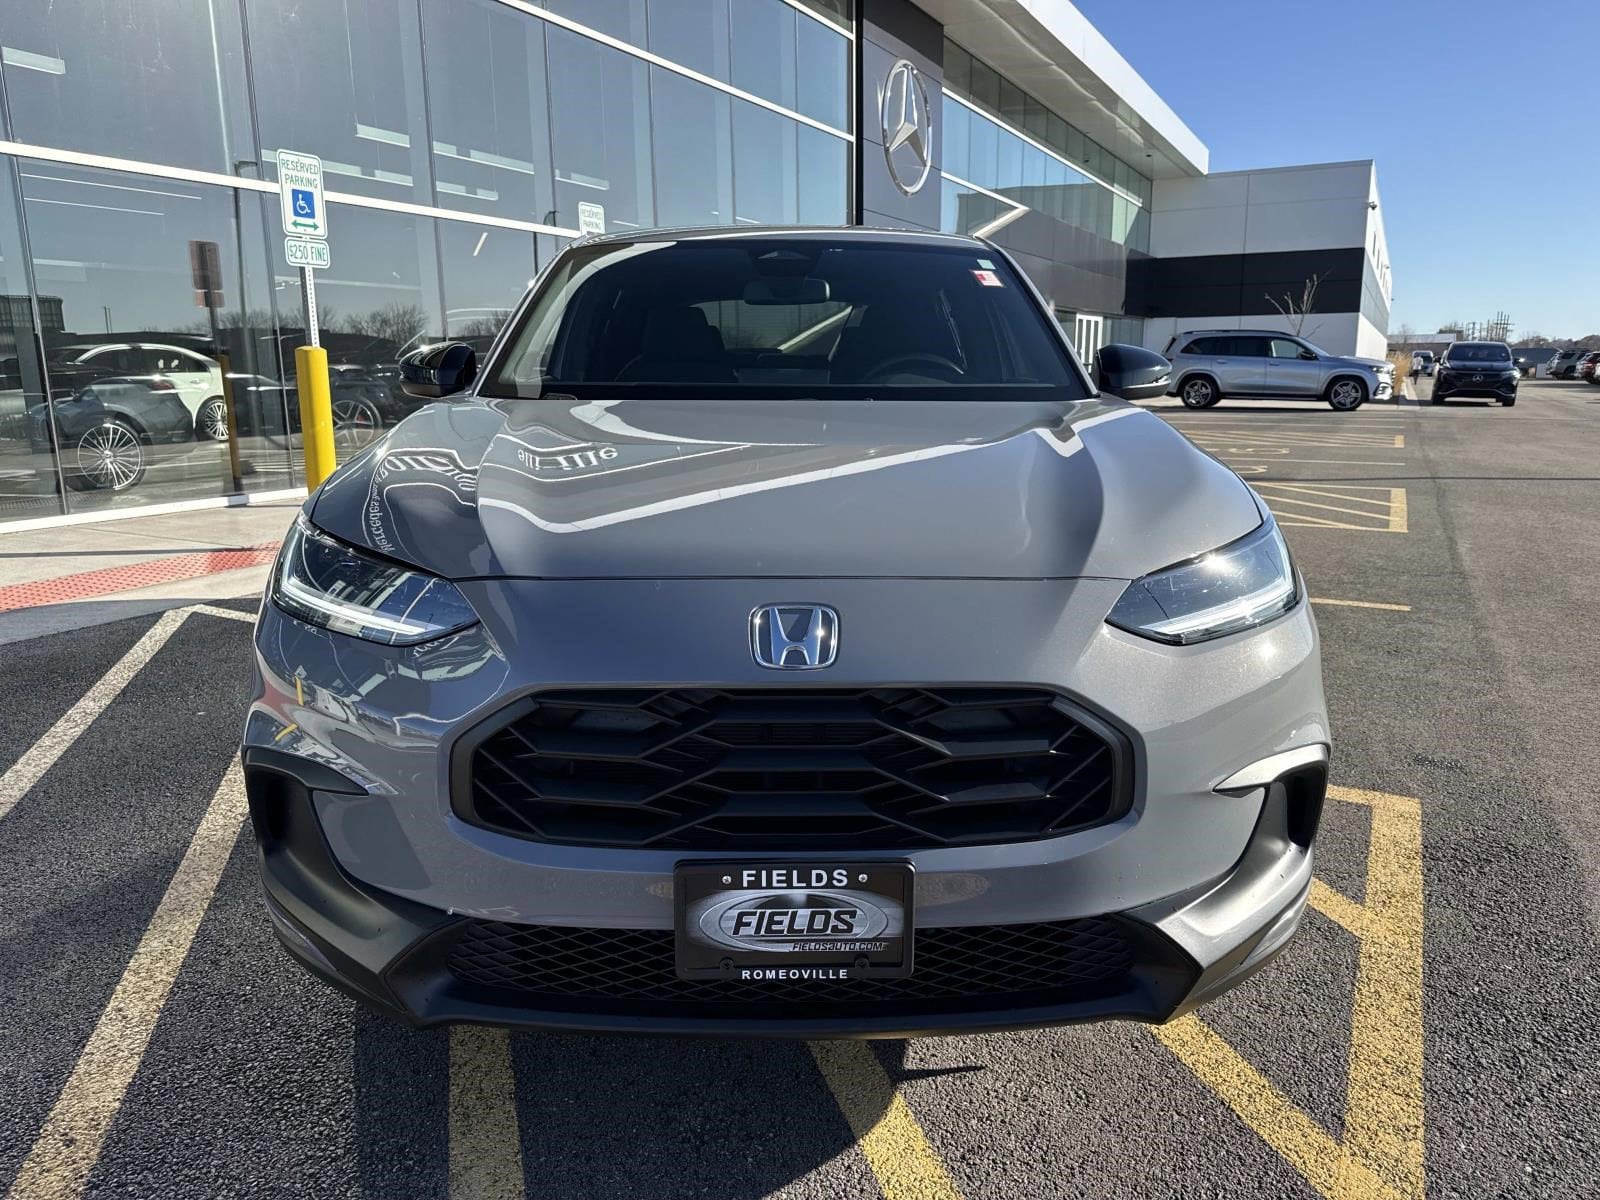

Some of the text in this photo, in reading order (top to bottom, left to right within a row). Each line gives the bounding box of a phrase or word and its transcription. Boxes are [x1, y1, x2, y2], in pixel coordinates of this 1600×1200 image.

[281, 159, 319, 175] RESERVED
[285, 174, 318, 189] PARKING
[288, 244, 327, 262] $250 FINE
[742, 869, 848, 887] FIELDS
[732, 909, 858, 936] FIELDS
[742, 969, 848, 979] ROMEOVILLE
